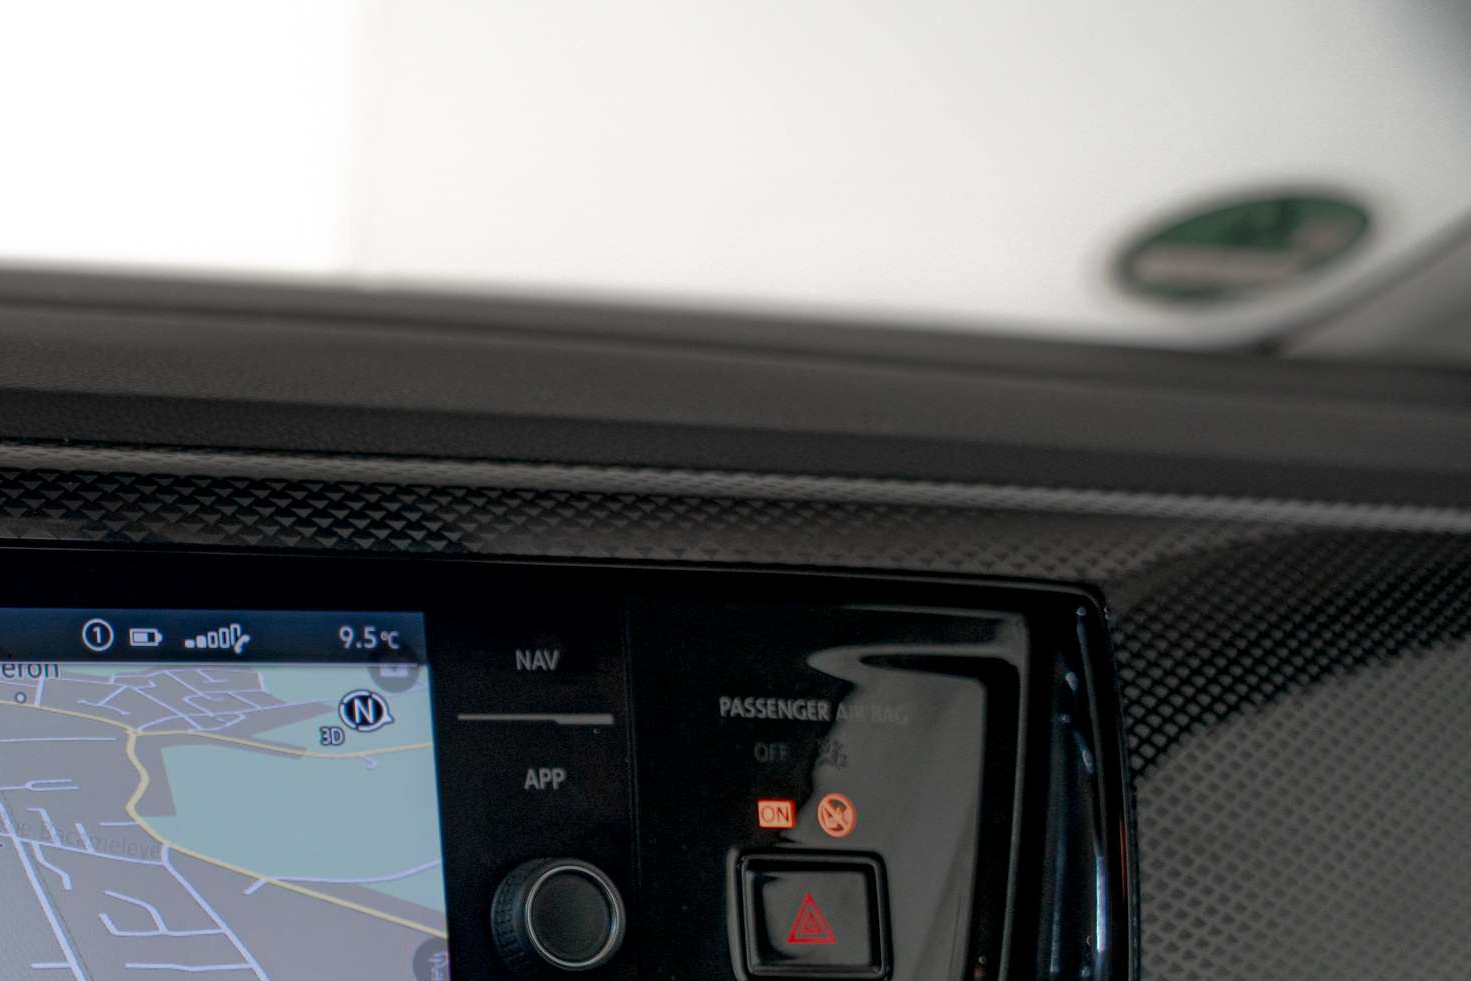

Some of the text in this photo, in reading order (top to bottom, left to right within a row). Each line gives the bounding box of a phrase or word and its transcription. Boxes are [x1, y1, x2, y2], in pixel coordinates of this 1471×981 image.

[515, 649, 560, 672] NAV
[719, 696, 830, 721] PASSENGER
[319, 726, 345, 746] 3D
[754, 741, 789, 763] OFF
[524, 767, 567, 791] APP
